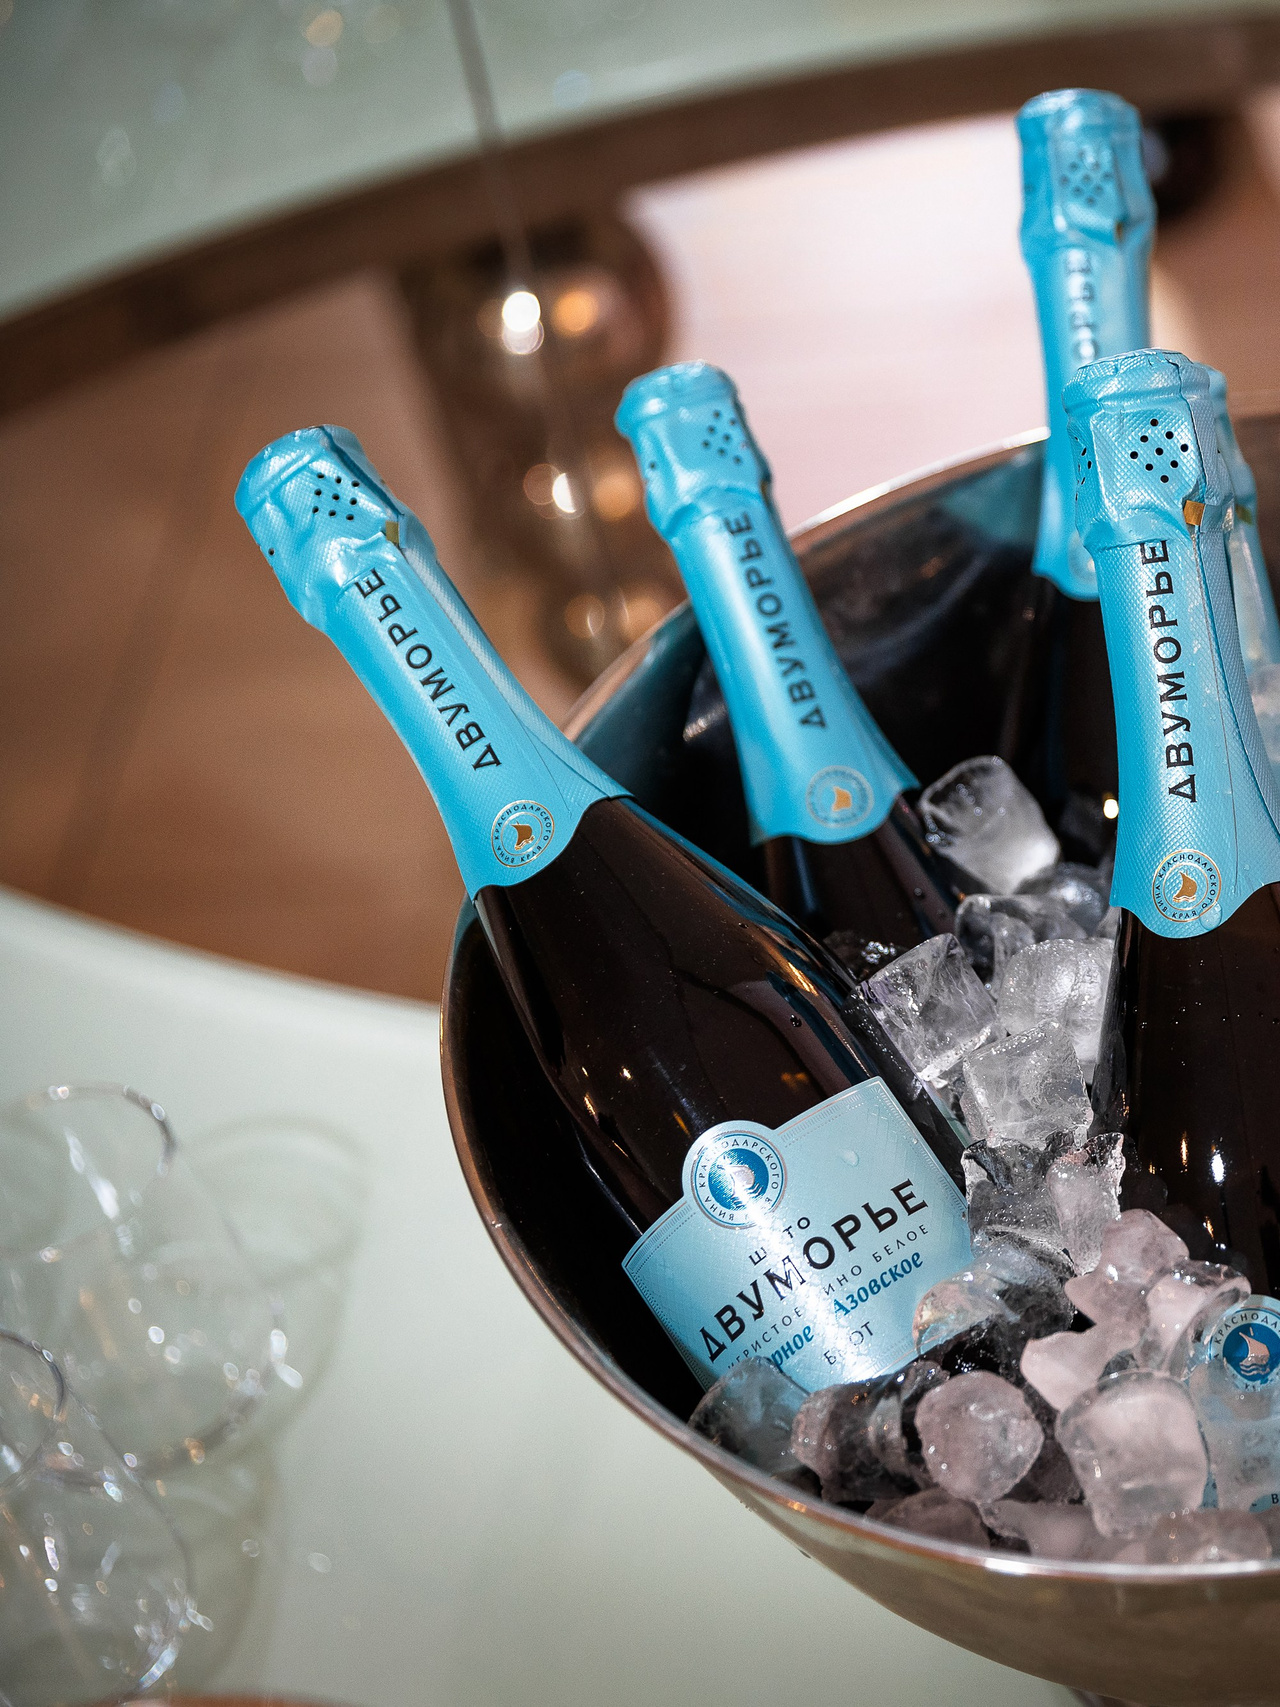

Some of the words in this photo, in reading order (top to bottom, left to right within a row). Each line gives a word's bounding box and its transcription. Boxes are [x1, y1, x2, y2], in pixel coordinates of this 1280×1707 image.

[723, 511, 826, 730] ДВУМОРЬЕ
[354, 568, 501, 772] ДВУМОРЬЕ
[1140, 540, 1197, 803] ДВУМОРЬЕ
[494, 804, 552, 841] КРАСНОДАРСКОГО
[1155, 885, 1168, 912] ВИНА
[1158, 854, 1217, 909] КРАСНОДАРСКОГО
[1172, 910, 1197, 919] КРАЯ
[748, 1217, 811, 1266] ШТО
[872, 1224, 929, 1263] БЕЛОЕ
[700, 1178, 929, 1362] ДВУМОРЬЕ
[771, 1325, 815, 1373] рное
[833, 1252, 924, 1320] Азовское
